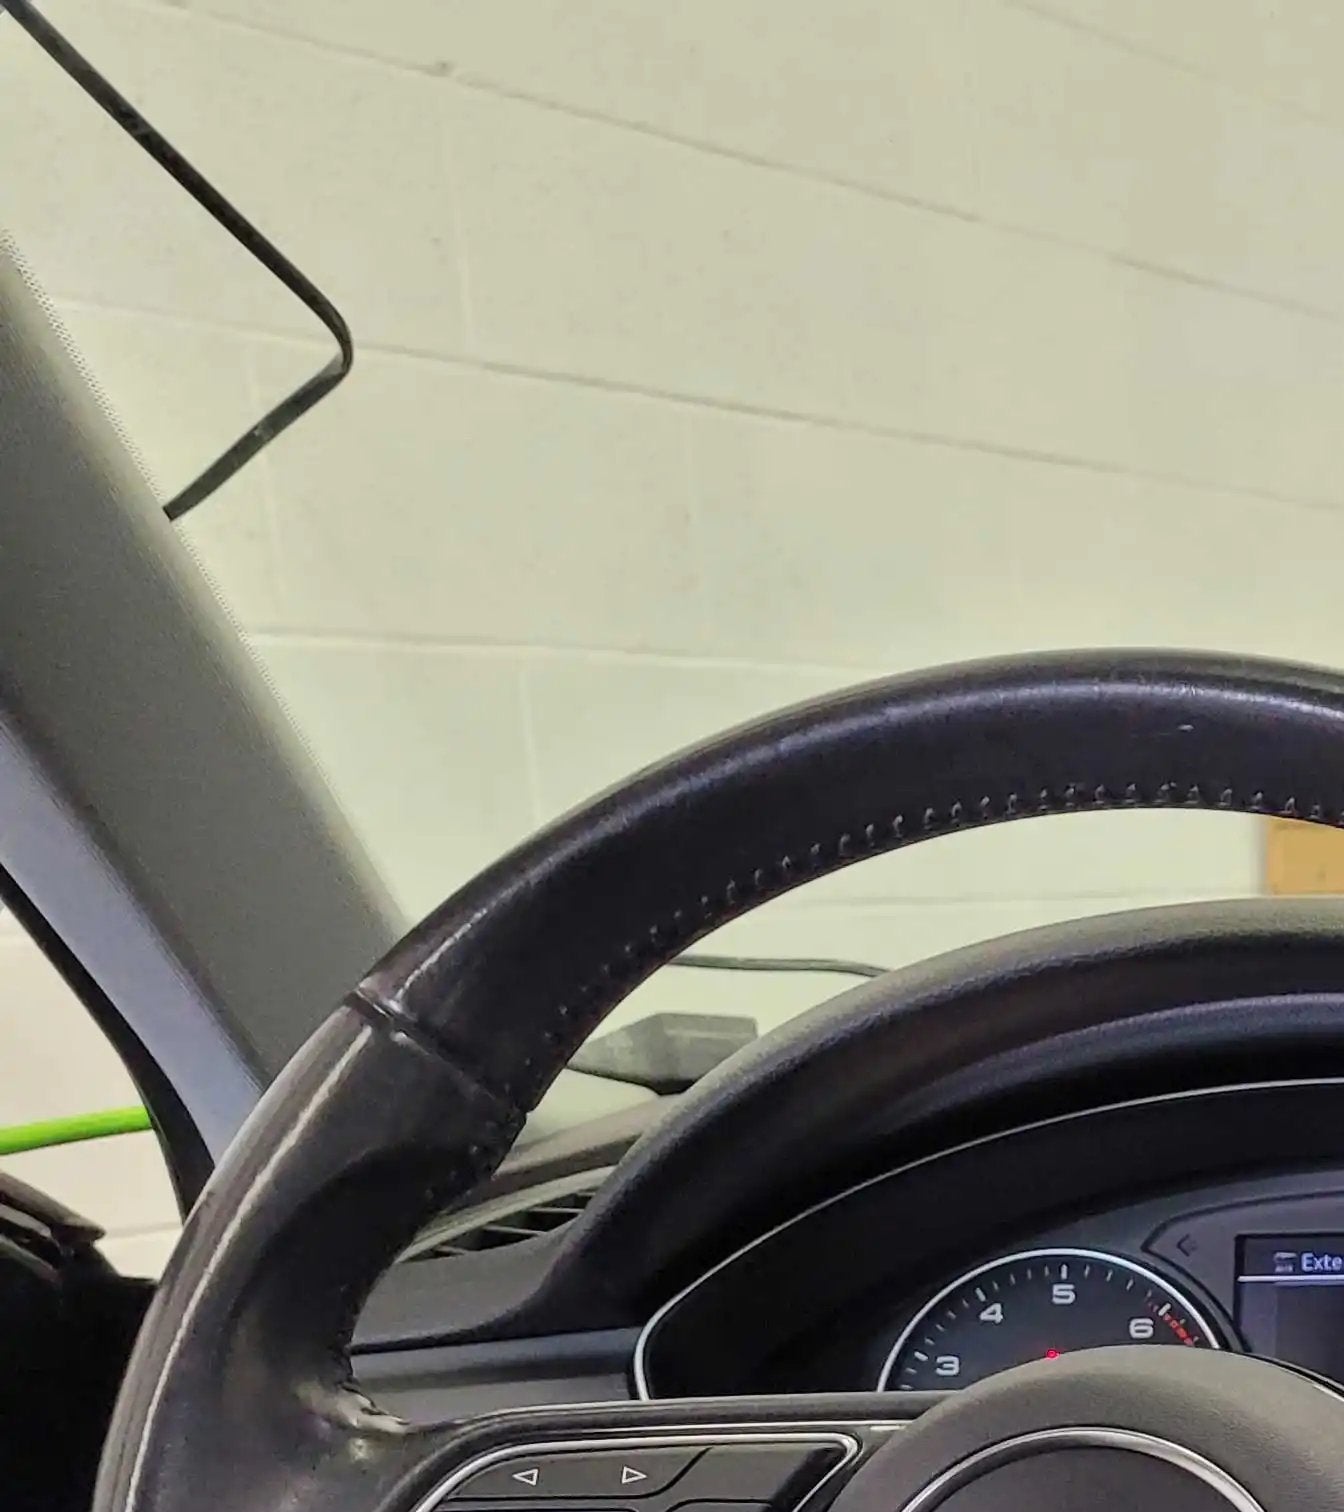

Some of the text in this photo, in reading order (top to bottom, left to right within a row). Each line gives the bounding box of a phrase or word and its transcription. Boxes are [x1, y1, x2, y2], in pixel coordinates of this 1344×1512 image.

[1051, 1283, 1076, 1305] 5
[979, 1303, 1004, 1324] 4
[1129, 1318, 1154, 1339] 6
[935, 1355, 960, 1376] 3
